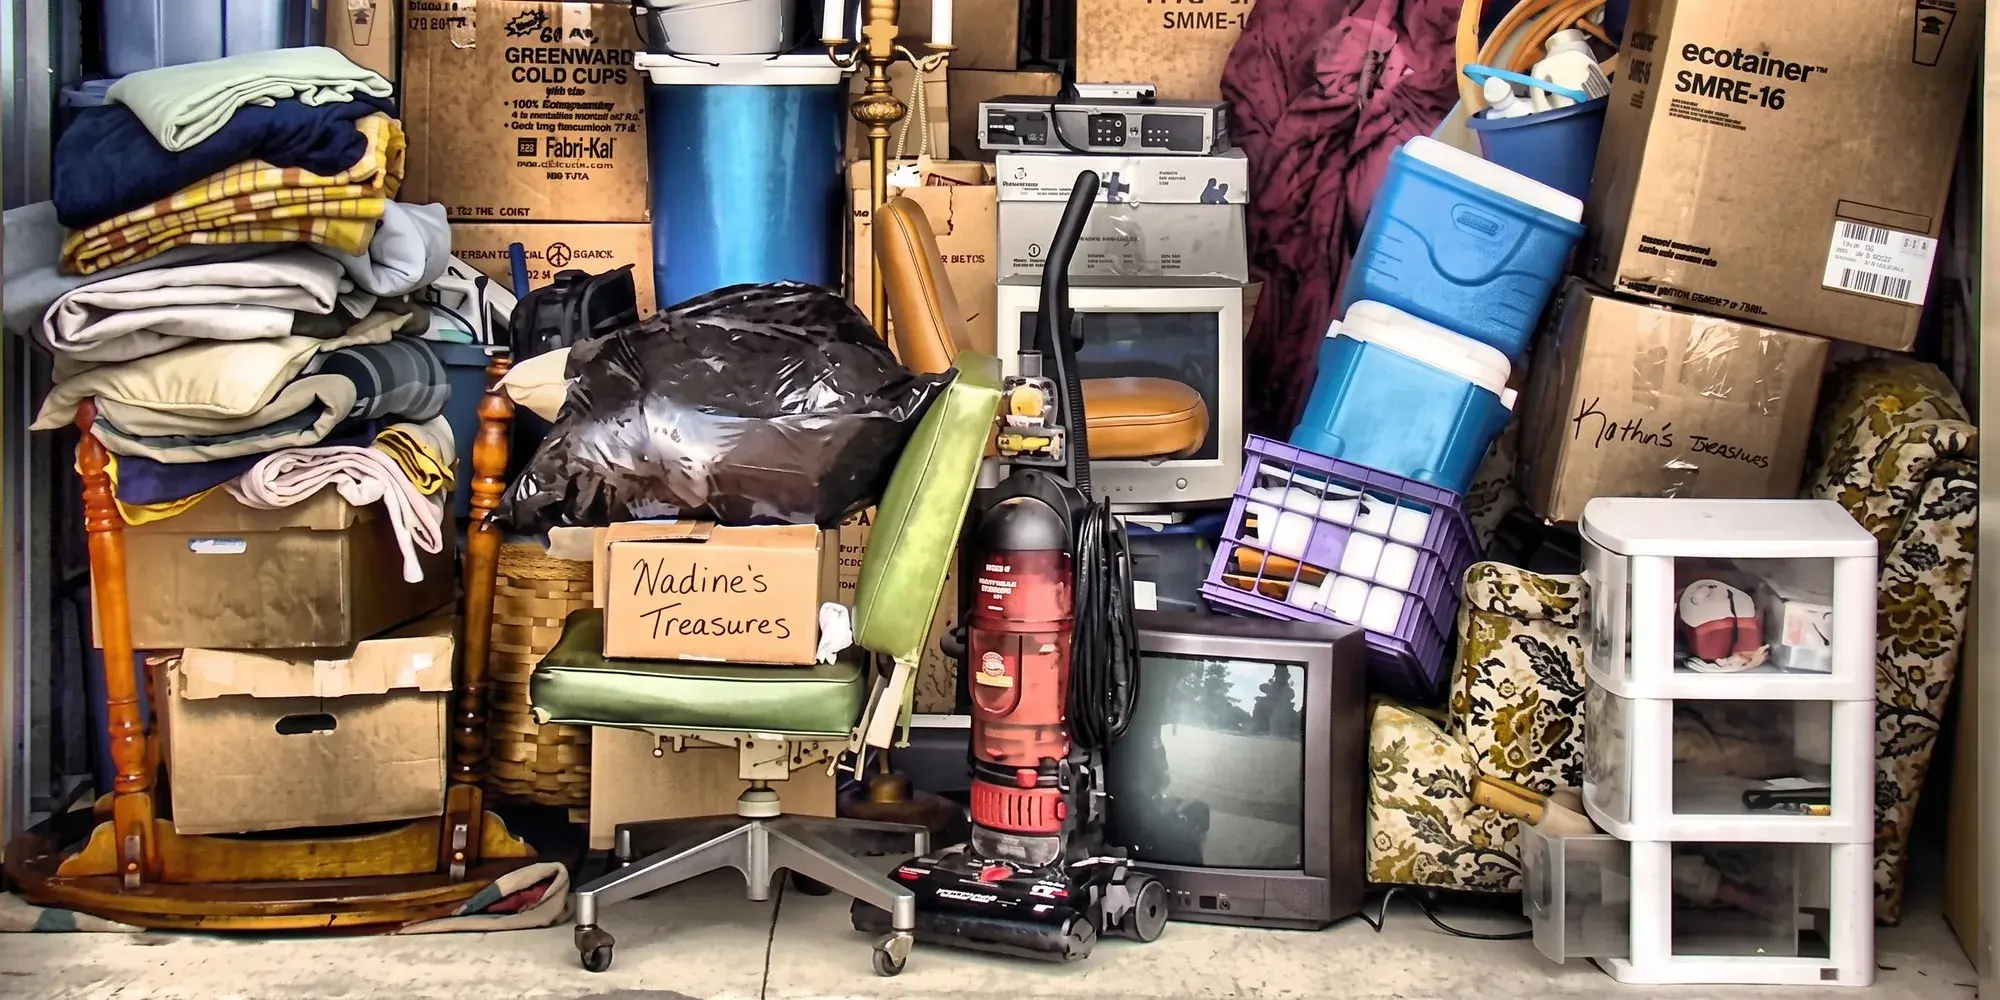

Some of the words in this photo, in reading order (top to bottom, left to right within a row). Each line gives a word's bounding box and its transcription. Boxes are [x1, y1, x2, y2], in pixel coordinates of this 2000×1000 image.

[505, 47, 633, 66] GREENWARD
[511, 66, 567, 83] COLD
[572, 67, 627, 85] CUPS
[1675, 70, 1786, 111] SMRE-16
[513, 99, 539, 109] 100%
[546, 136, 614, 159] Fabri-Kal
[475, 207, 494, 216] THE
[632, 557, 769, 597] Nadine's
[639, 602, 791, 640] Treasures
